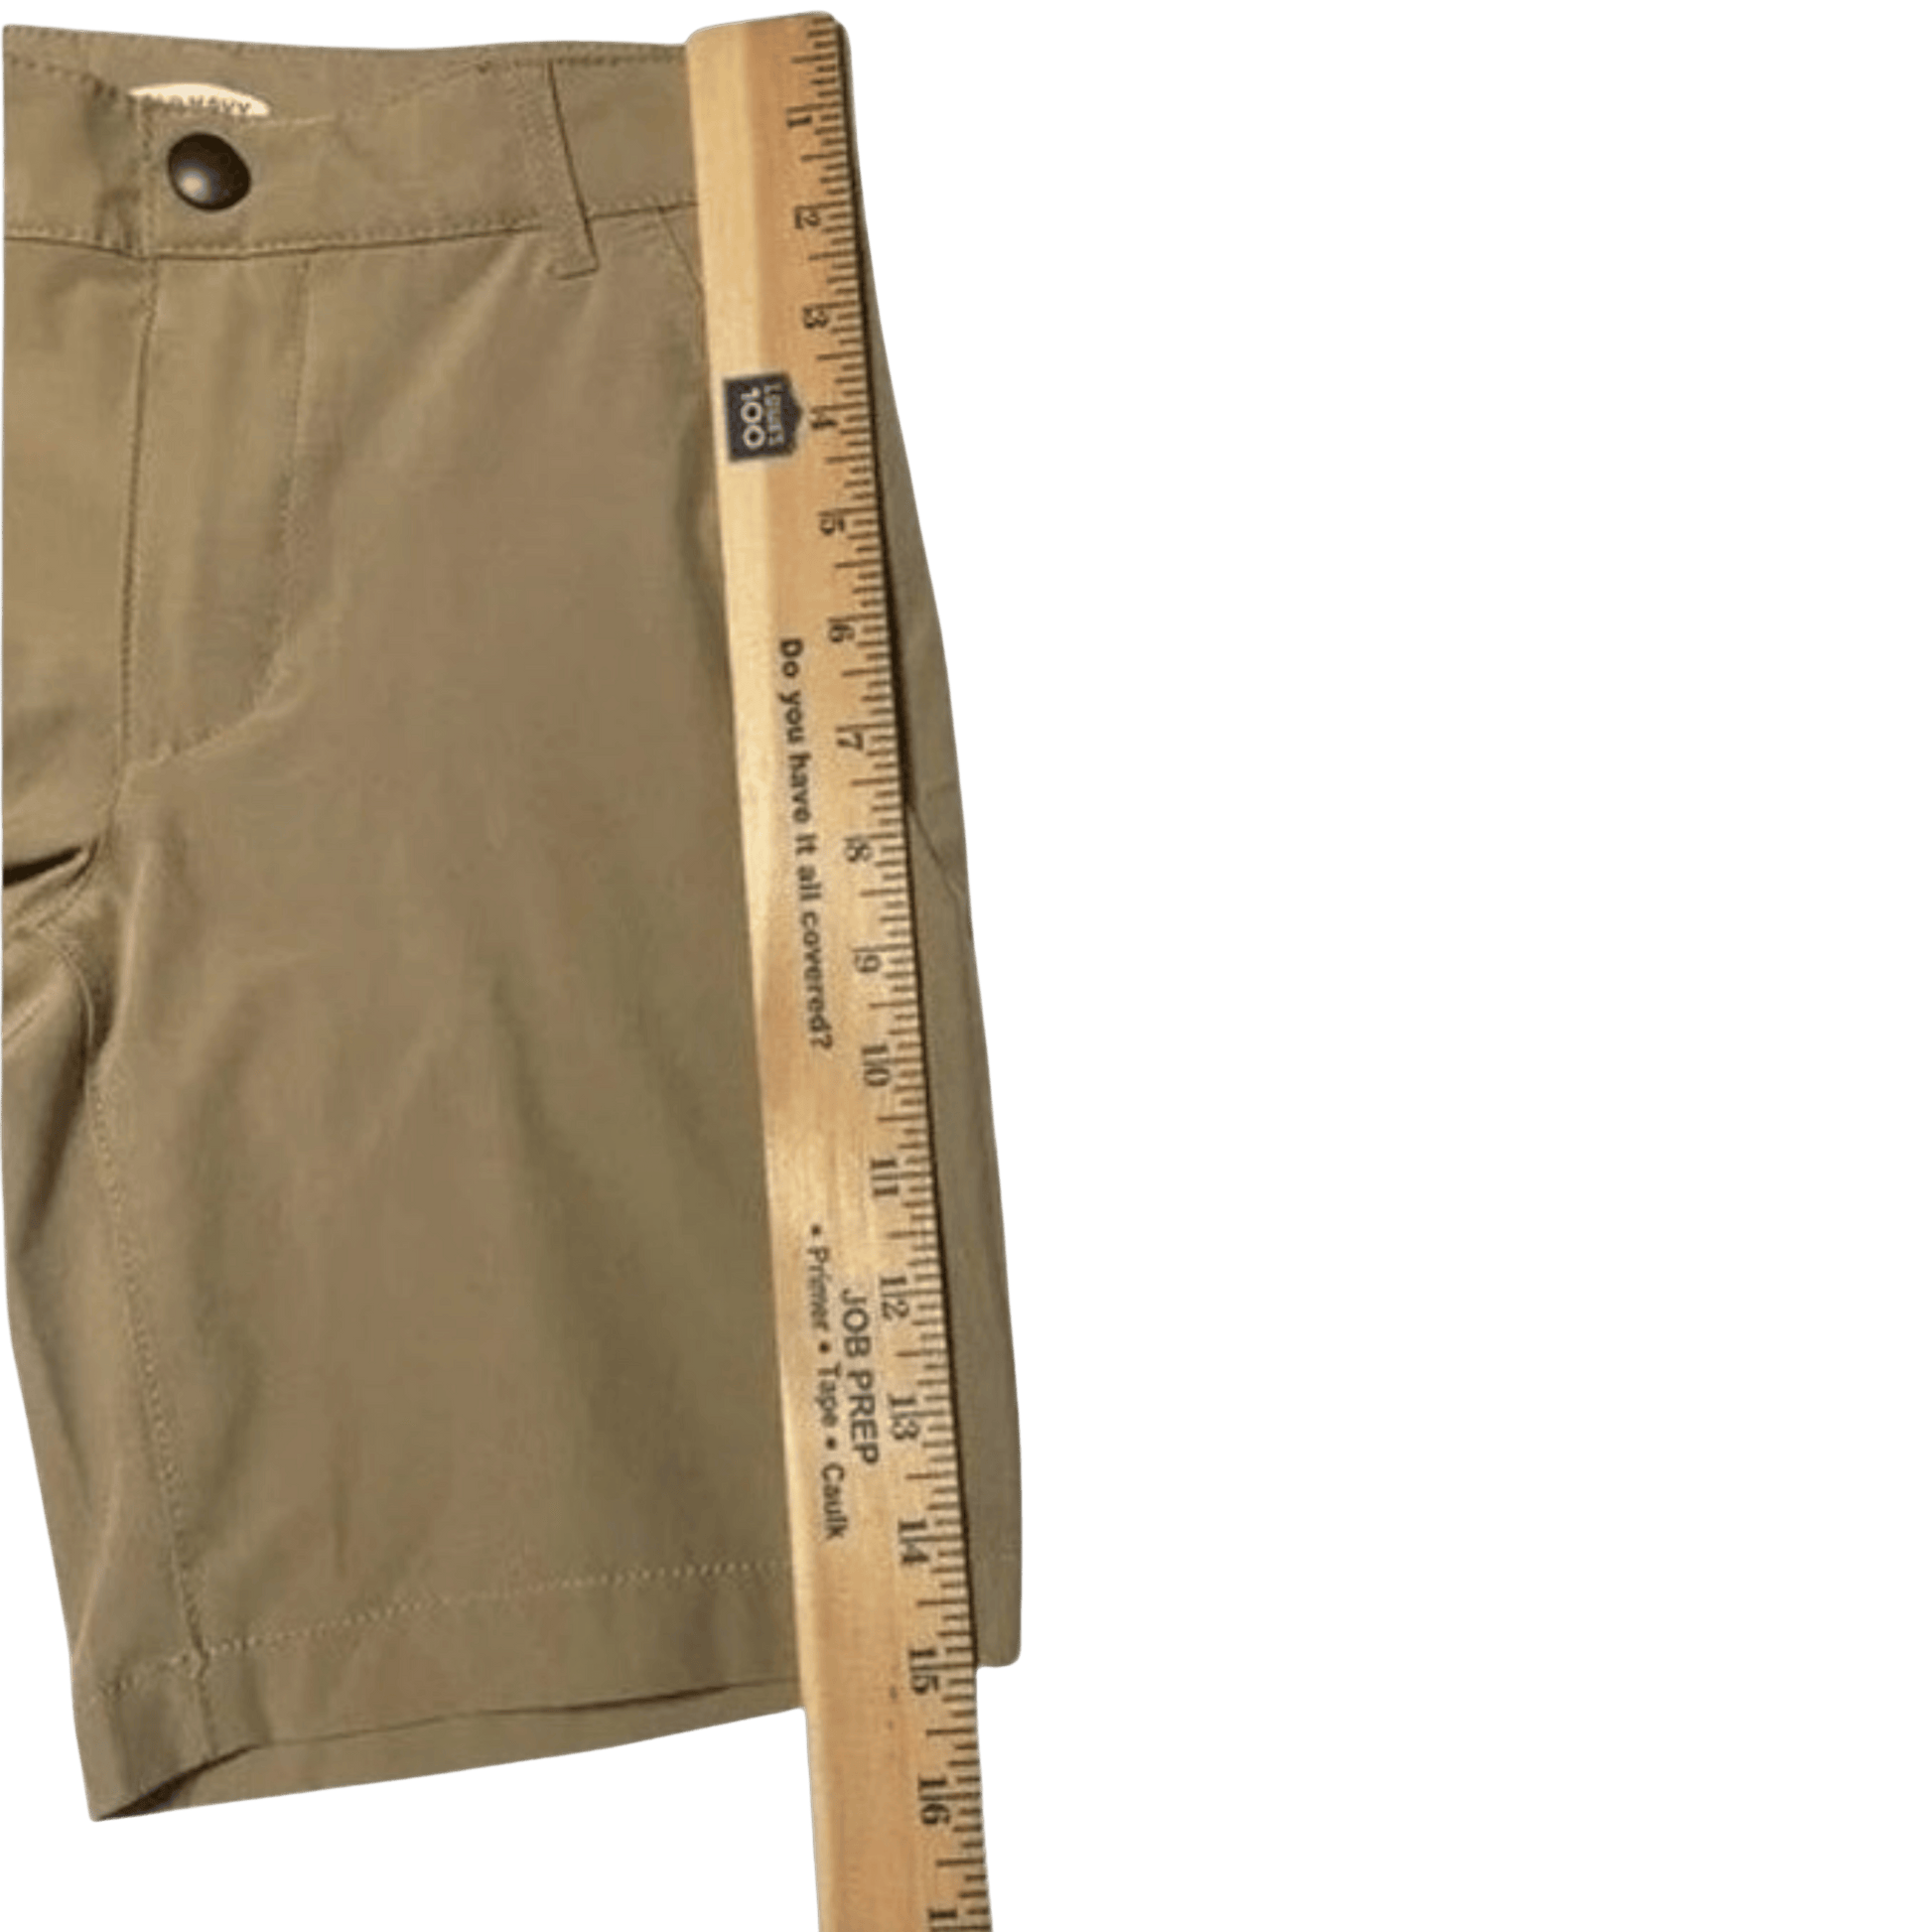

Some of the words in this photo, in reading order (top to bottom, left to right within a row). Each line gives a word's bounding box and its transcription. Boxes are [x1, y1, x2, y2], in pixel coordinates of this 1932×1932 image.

[786, 115, 813, 129] 1
[794, 210, 821, 230] 2
[802, 307, 830, 330] 3
[741, 386, 766, 450] 100
[809, 412, 838, 430] 4
[819, 517, 846, 536] 5
[828, 622, 856, 643] 6
[779, 638, 804, 679] Do
[777, 690, 805, 744] you
[836, 732, 864, 751] 7
[787, 753, 813, 823] have
[795, 833, 818, 857] it
[845, 841, 874, 863] 8
[797, 864, 823, 901] all
[801, 910, 834, 1050] covered?
[854, 953, 882, 974] 9
[861, 1043, 891, 1087] 10
[870, 1158, 899, 1197] 11
[806, 1245, 831, 1331] Primer
[879, 1275, 910, 1320] 12
[840, 1287, 873, 1358] JOB
[814, 1361, 842, 1428] Tape
[846, 1369, 881, 1464] PREP
[888, 1392, 921, 1440] 13
[821, 1462, 849, 1540] Caulk
[897, 1518, 930, 1566] 14
[908, 1646, 939, 1695] 15
[917, 1773, 951, 1826] 16
